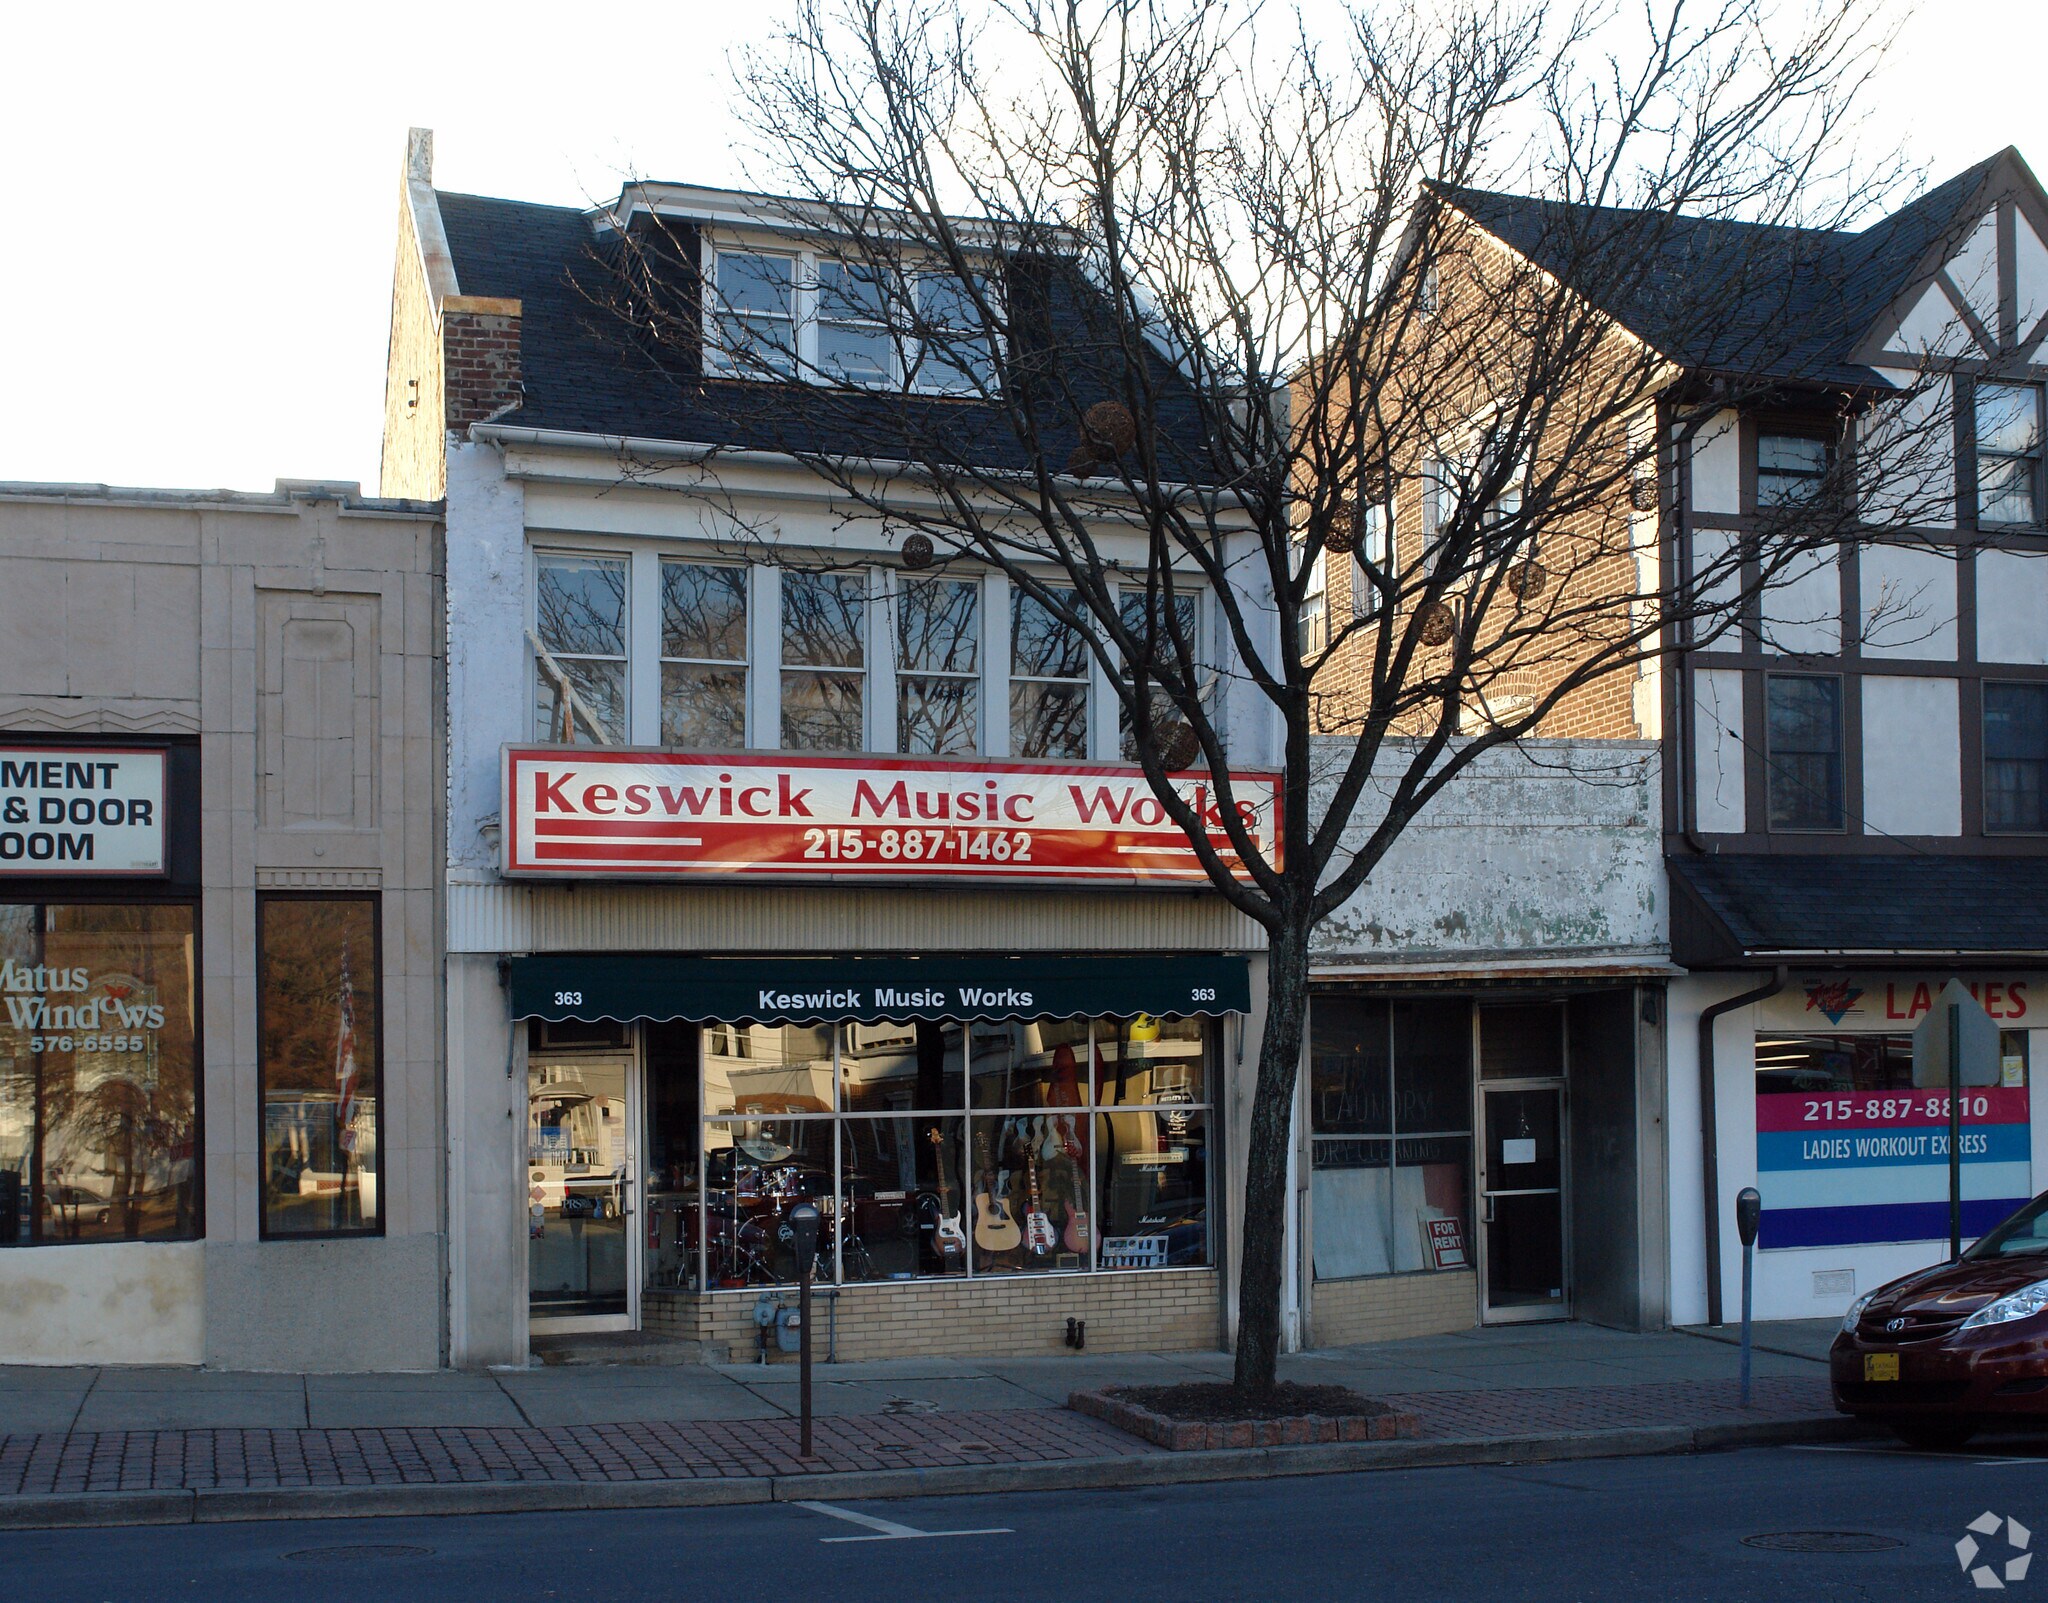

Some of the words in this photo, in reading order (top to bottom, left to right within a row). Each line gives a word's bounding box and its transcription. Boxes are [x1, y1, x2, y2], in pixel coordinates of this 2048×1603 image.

[1, 760, 119, 789] MENT
[534, 771, 813, 818] Keswick
[851, 779, 1034, 822] Music
[3, 796, 30, 824] &
[39, 797, 153, 826] DOOR
[0, 831, 94, 861] OOM
[803, 828, 1032, 861] 215-887-1462
[554, 991, 583, 1006] 363
[758, 988, 861, 1010] Keswick
[874, 988, 946, 1008] Music
[958, 987, 1034, 1007] Works
[1191, 987, 1216, 1001] 363
[1886, 981, 2027, 1019] LAES
[4, 996, 165, 1030] Windows
[30, 1035, 144, 1053] 576-6555
[1804, 1096, 1989, 1121] 215-887-8810
[1803, 1139, 1850, 1160] LADIES
[1855, 1136, 1927, 1158] WORKOUT
[1434, 1222, 1456, 1235] FOR
[1433, 1236, 1461, 1250] RENT
